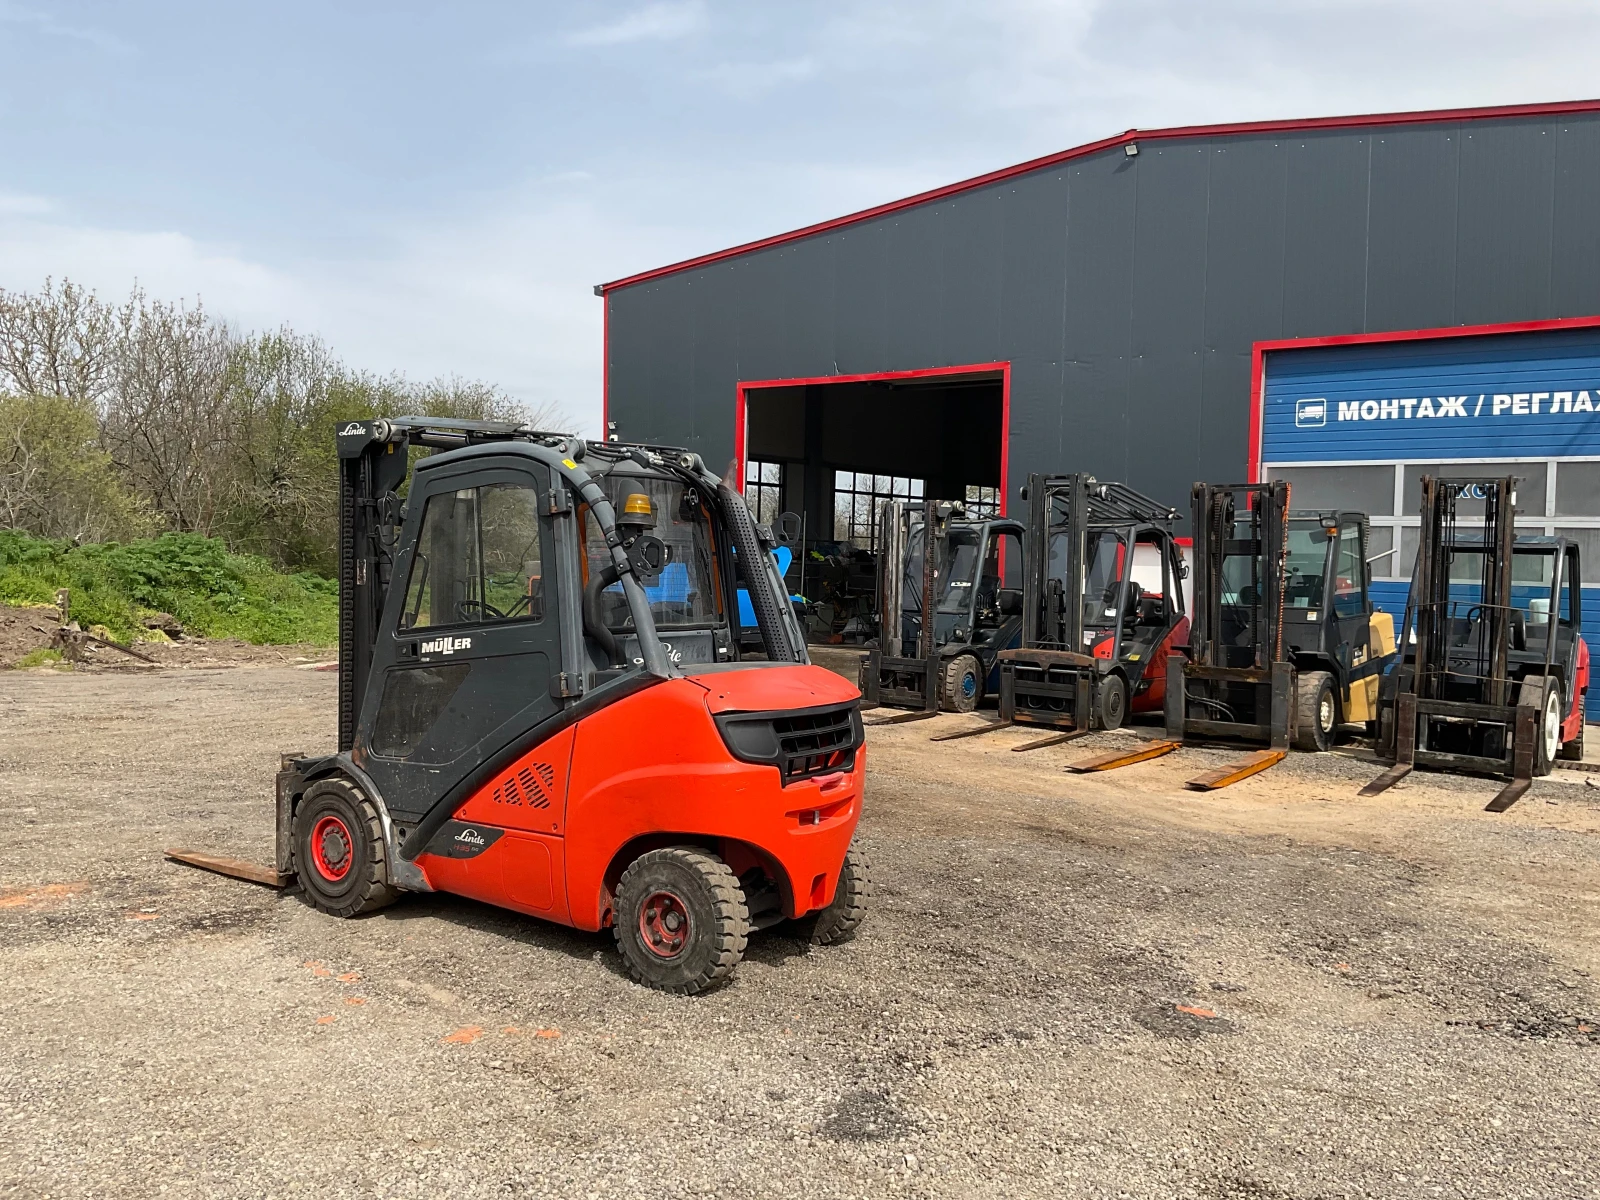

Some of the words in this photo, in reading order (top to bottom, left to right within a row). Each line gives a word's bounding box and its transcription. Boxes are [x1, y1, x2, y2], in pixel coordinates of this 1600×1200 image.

[1338, 396, 1468, 421] МОНТАЖ
[1474, 394, 1485, 417] /
[1492, 389, 1600, 416] РЕГЛА
[338, 422, 367, 437] Linde
[454, 828, 485, 845] Linde
